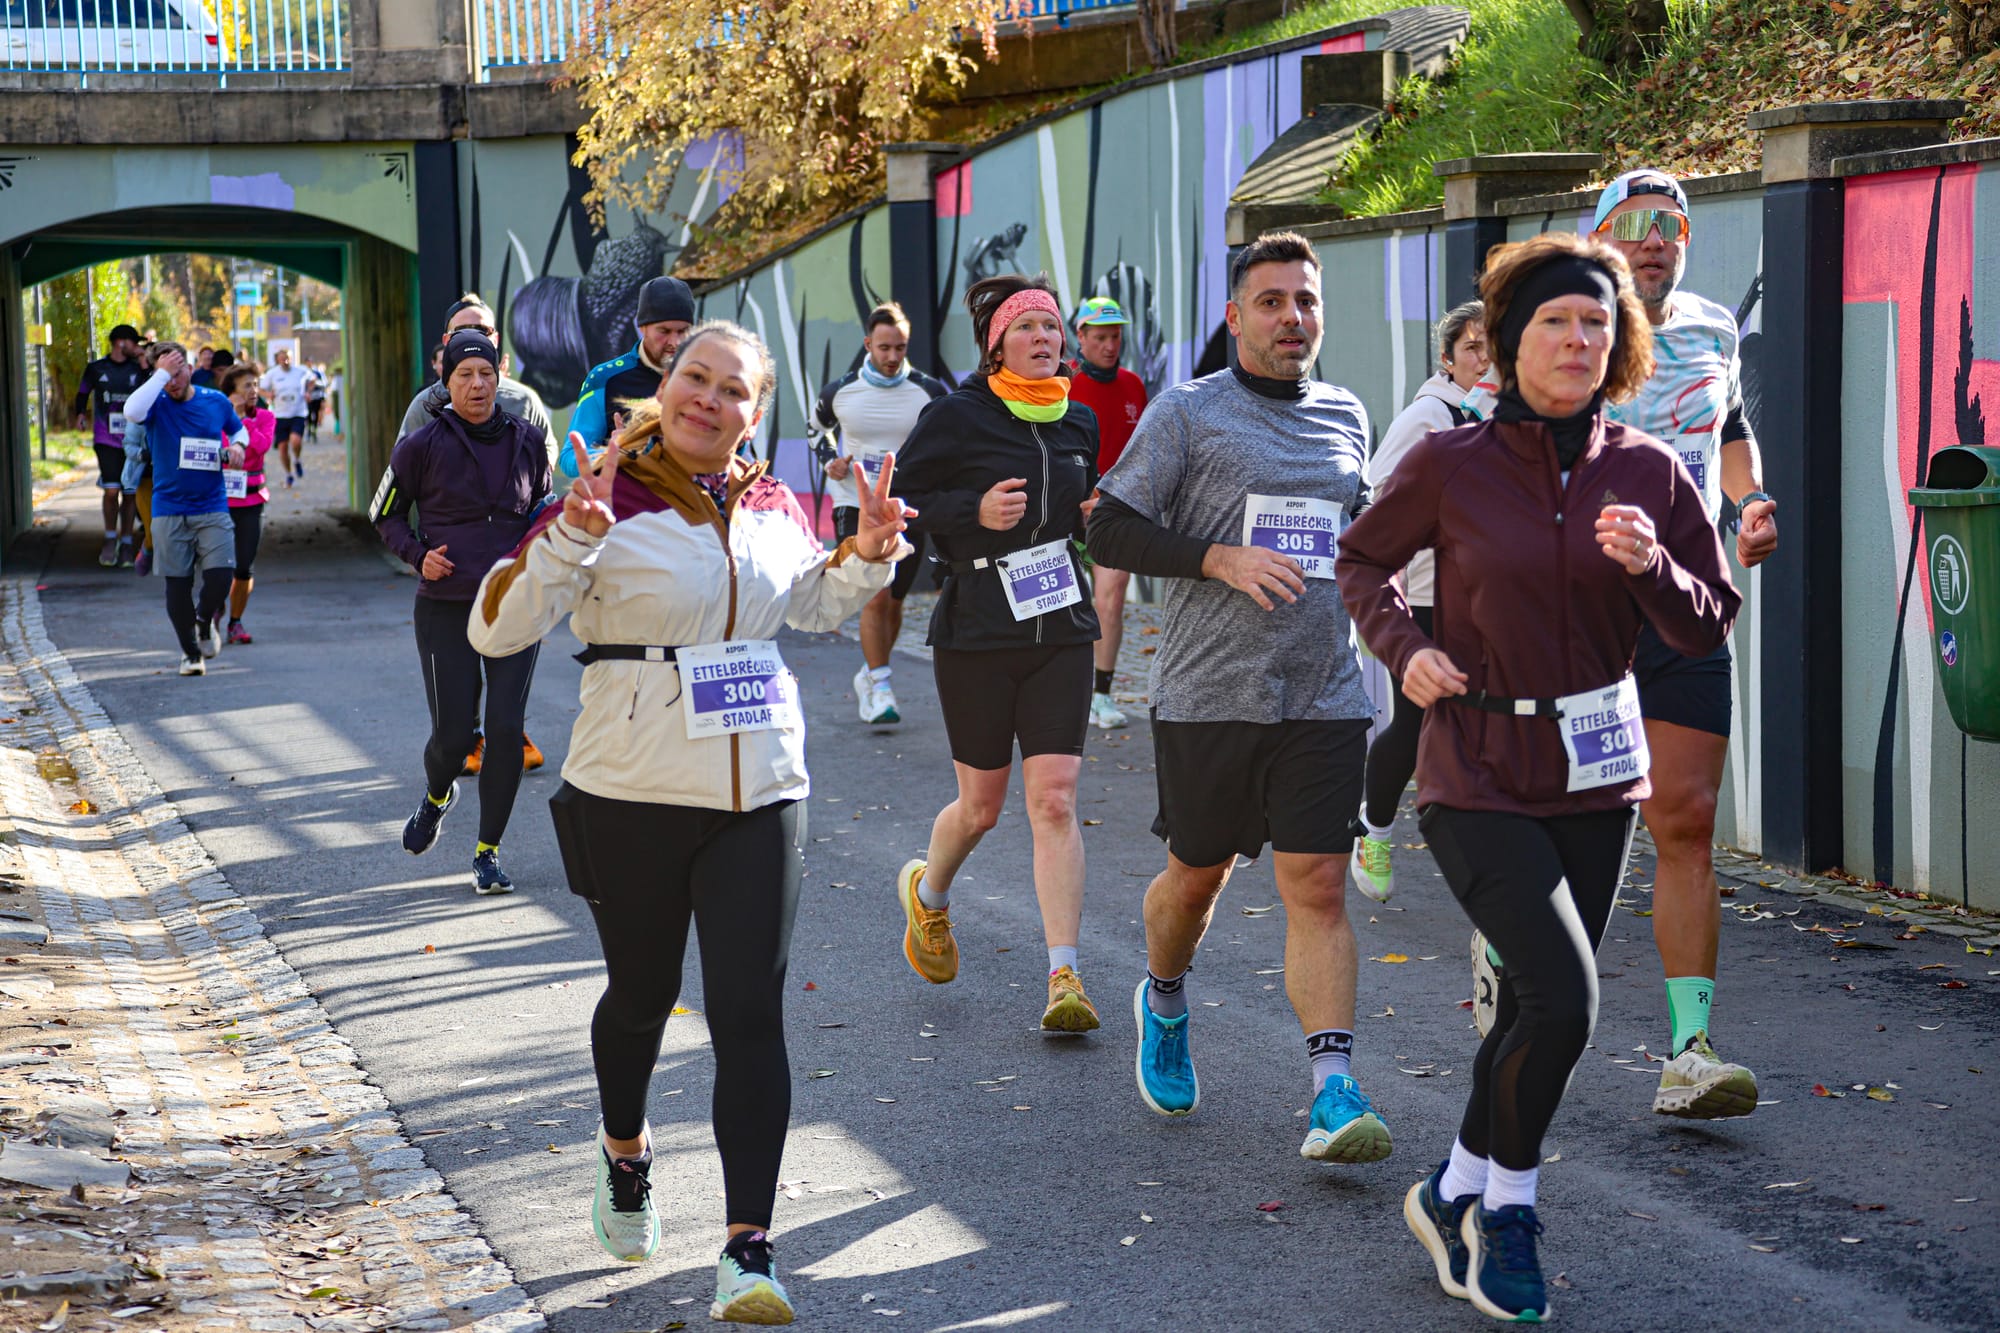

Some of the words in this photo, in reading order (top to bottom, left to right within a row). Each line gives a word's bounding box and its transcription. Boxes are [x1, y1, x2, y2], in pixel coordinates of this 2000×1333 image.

[1285, 501, 1307, 509] ASPORT
[1255, 512, 1333, 531] ETTELBRÉCKER
[1276, 532, 1315, 551] 305
[1038, 573, 1059, 591] 35
[1035, 590, 1068, 610] STADLAF
[725, 644, 749, 655] ASPORT
[723, 680, 766, 704] 300
[722, 708, 773, 728] STADLAF
[1600, 724, 1636, 754] 301
